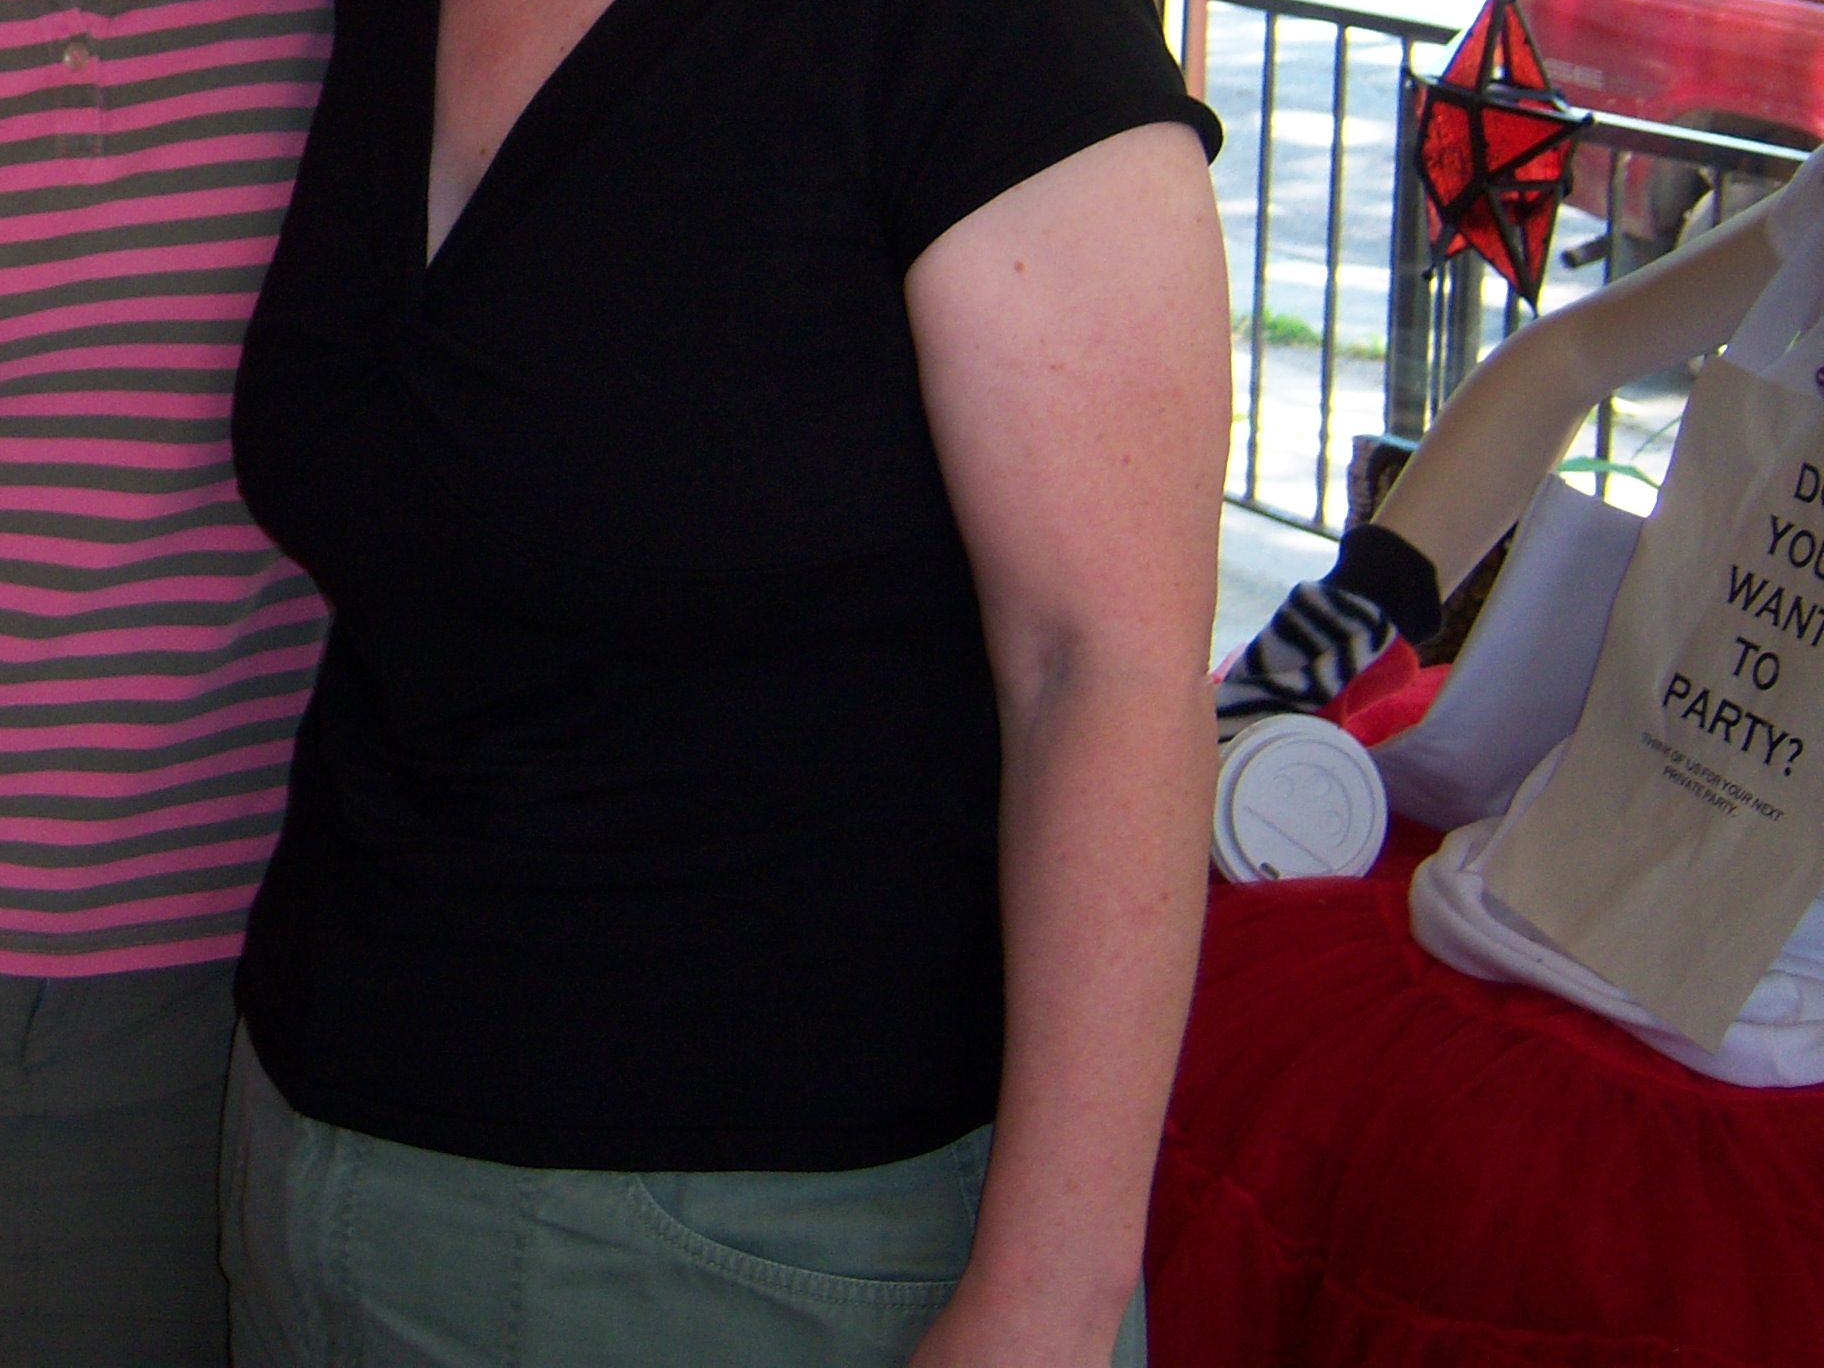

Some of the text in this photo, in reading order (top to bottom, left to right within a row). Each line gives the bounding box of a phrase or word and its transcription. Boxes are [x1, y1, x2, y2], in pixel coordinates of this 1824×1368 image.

[1794, 461, 1824, 505] D
[1733, 636, 1780, 690] TO
[1662, 672, 1804, 777] PARTY?
[1641, 731, 1787, 822] THINK OF US FOR YOUR NEXT
[1663, 765, 1704, 798] PRIVATE
